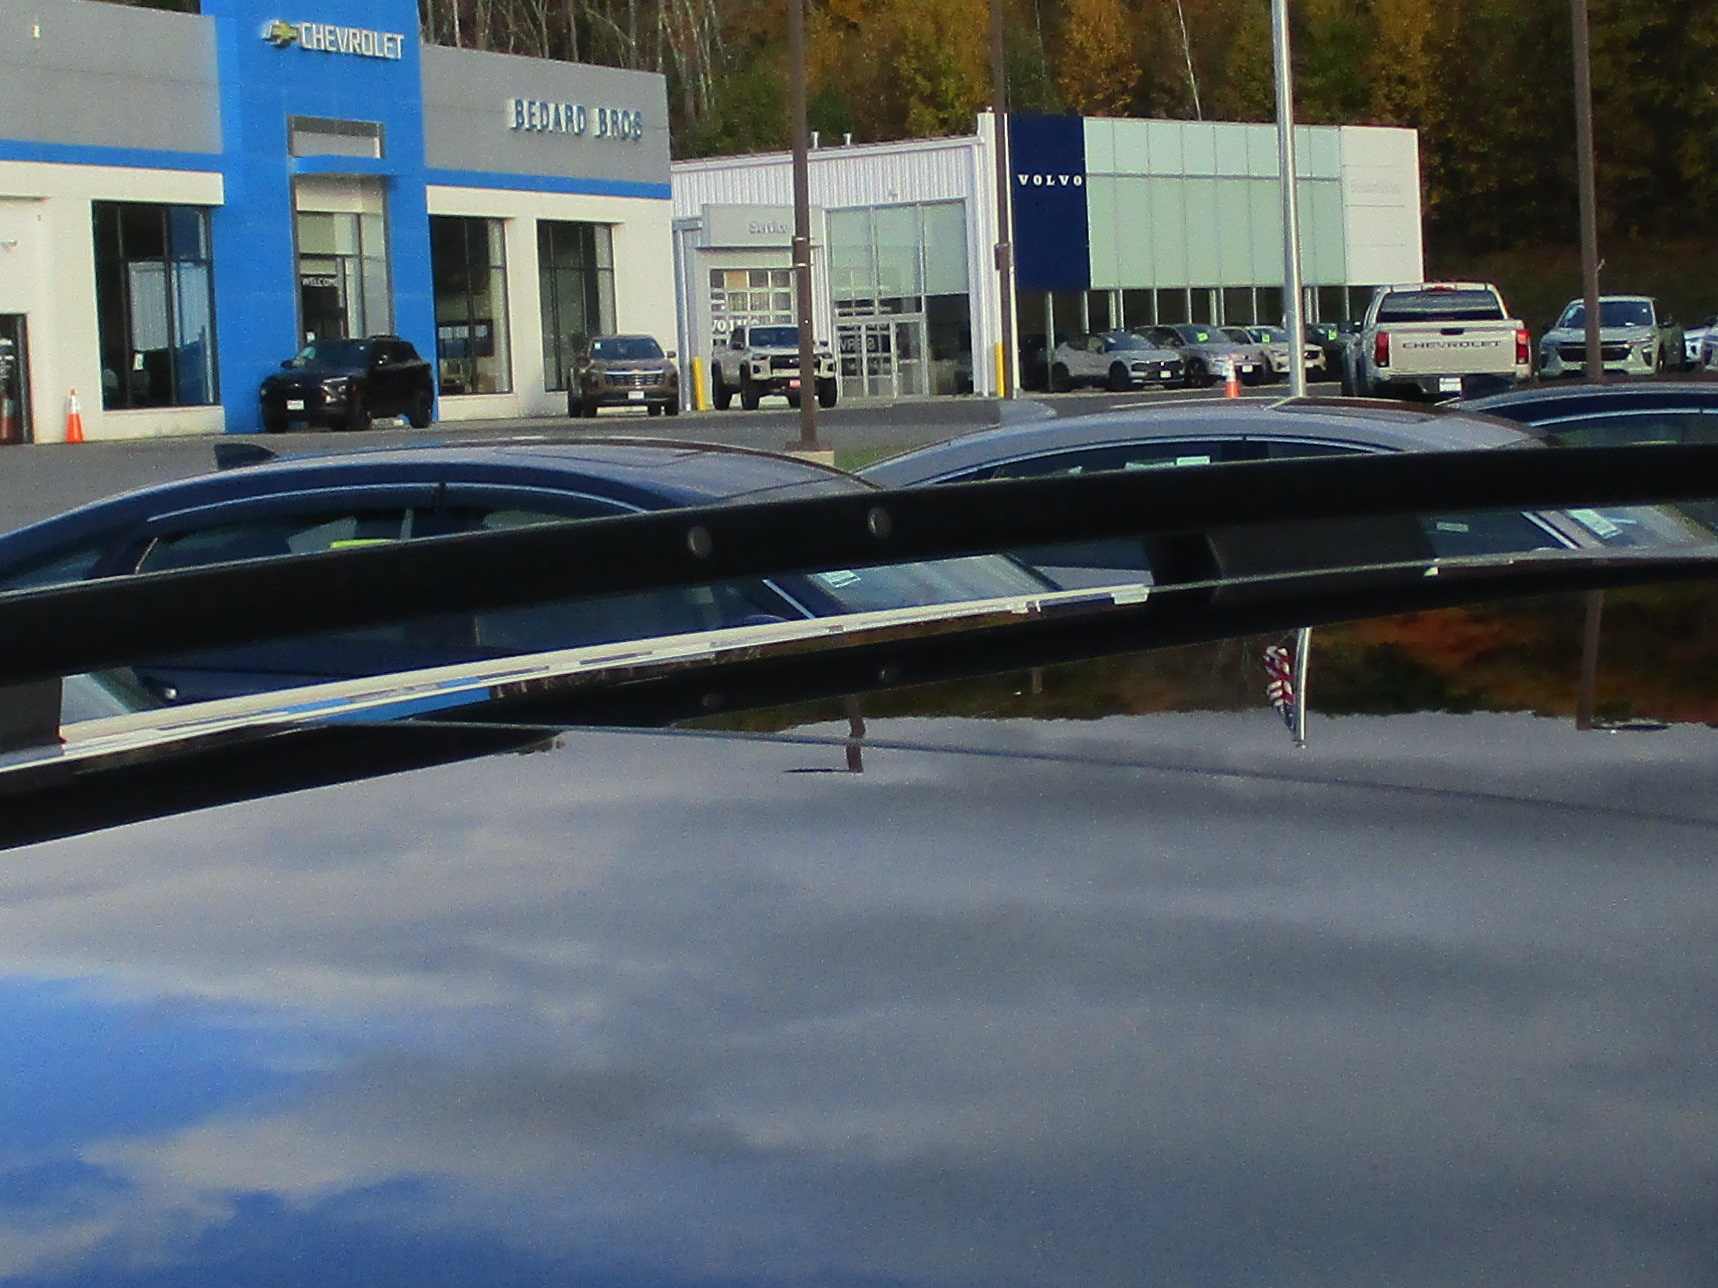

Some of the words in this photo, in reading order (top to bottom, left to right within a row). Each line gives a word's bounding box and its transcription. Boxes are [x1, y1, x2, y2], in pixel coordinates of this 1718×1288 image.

[300, 21, 405, 60] CHEVROLET
[507, 98, 587, 136] BEDARD
[594, 107, 643, 141] BROS
[1017, 173, 1083, 187] VOLVO
[1403, 340, 1501, 350] CHEVROLET
